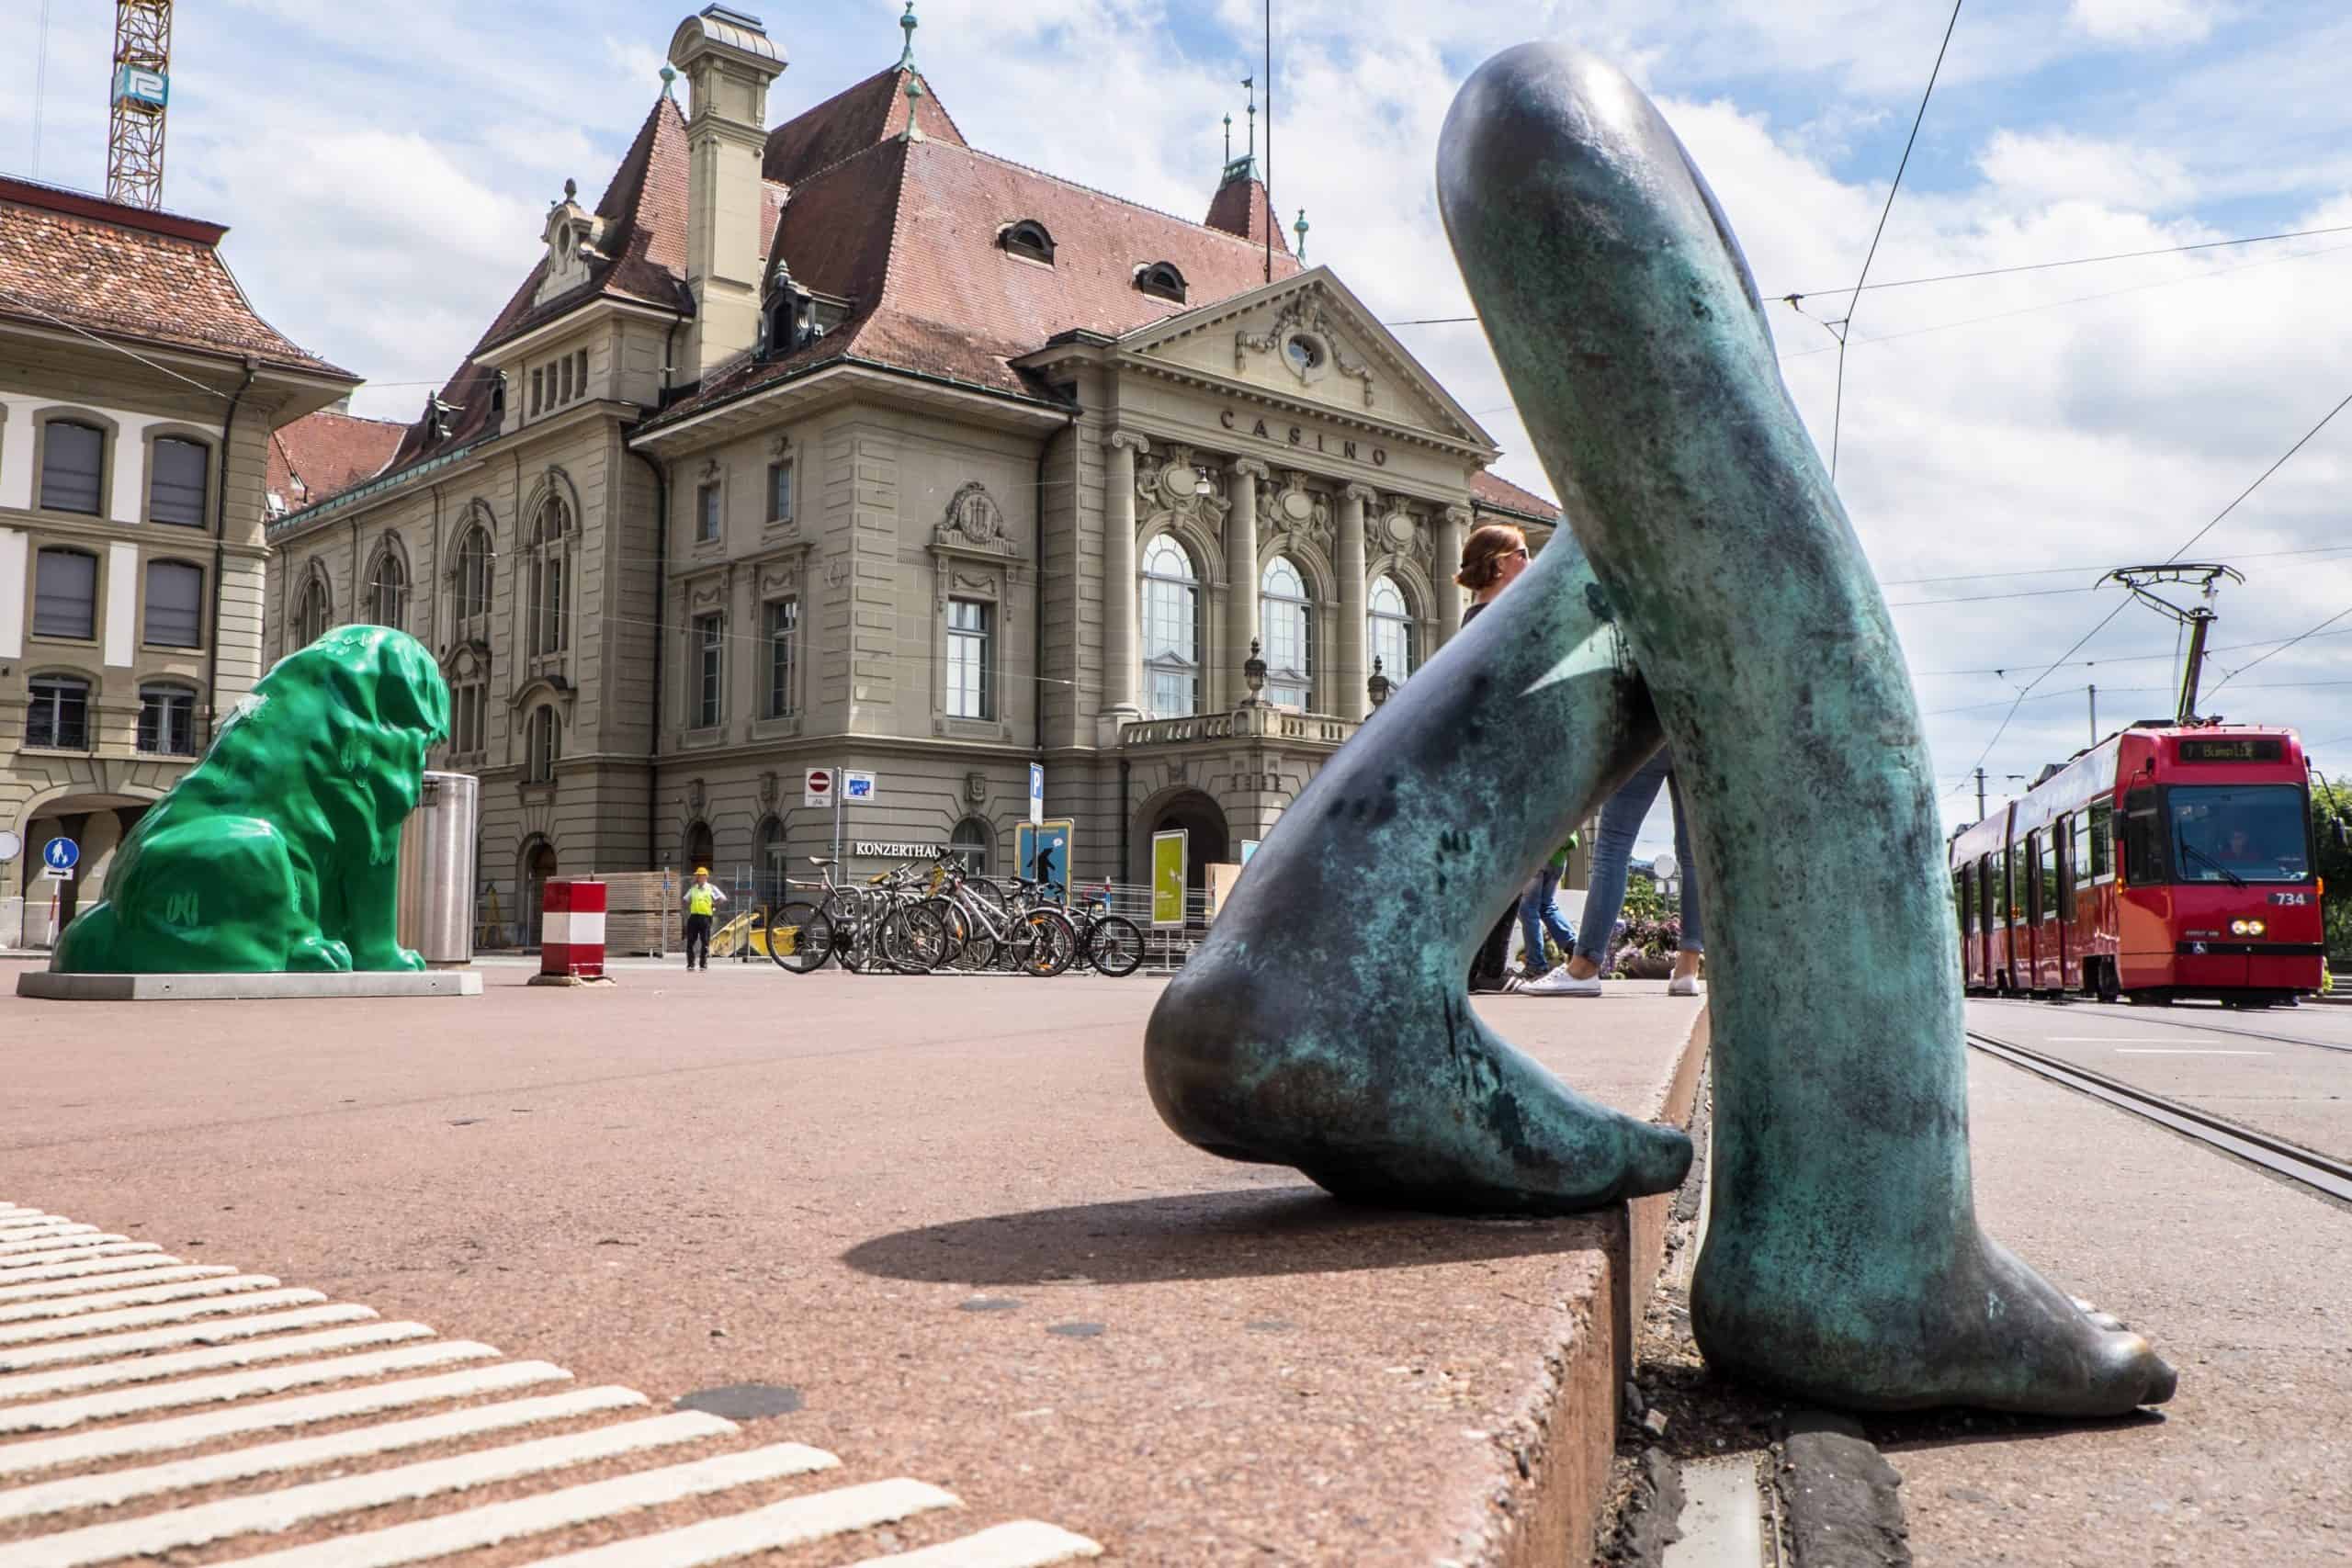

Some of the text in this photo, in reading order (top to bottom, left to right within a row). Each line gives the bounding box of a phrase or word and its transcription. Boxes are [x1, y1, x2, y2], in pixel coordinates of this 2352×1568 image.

[1220, 411, 1386, 467] CASINO
[1033, 771, 1041, 795] P
[2277, 893, 2305, 906] 734
